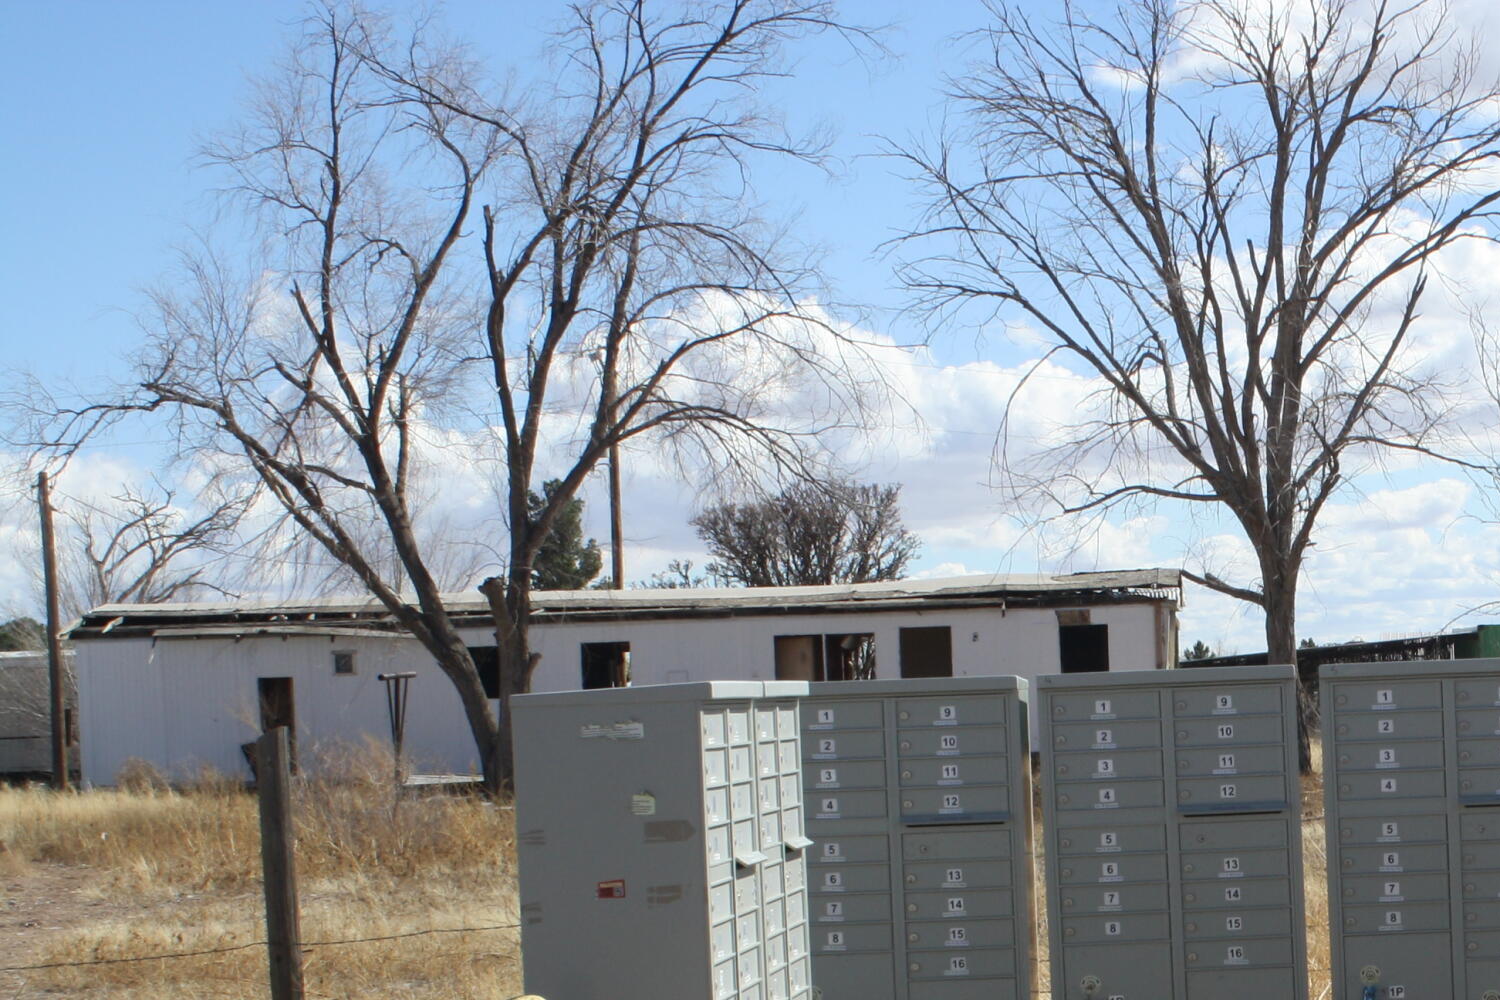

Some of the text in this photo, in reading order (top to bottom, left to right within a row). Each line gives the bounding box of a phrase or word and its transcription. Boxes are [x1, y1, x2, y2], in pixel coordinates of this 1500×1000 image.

[1220, 726, 1232, 737] 10
[943, 737, 956, 747] 10
[1221, 756, 1233, 766] 11
[944, 766, 957, 777] 11
[1222, 786, 1235, 797] 12
[945, 796, 958, 806] 12
[1225, 859, 1238, 869] 13
[948, 870, 961, 881] 13
[1226, 889, 1240, 899] 14
[950, 899, 962, 910] 14
[1228, 918, 1241, 929] 15
[951, 929, 964, 939] 15
[1230, 948, 1243, 958] 16
[952, 959, 965, 969] 16
[1390, 986, 1404, 997] 1P
